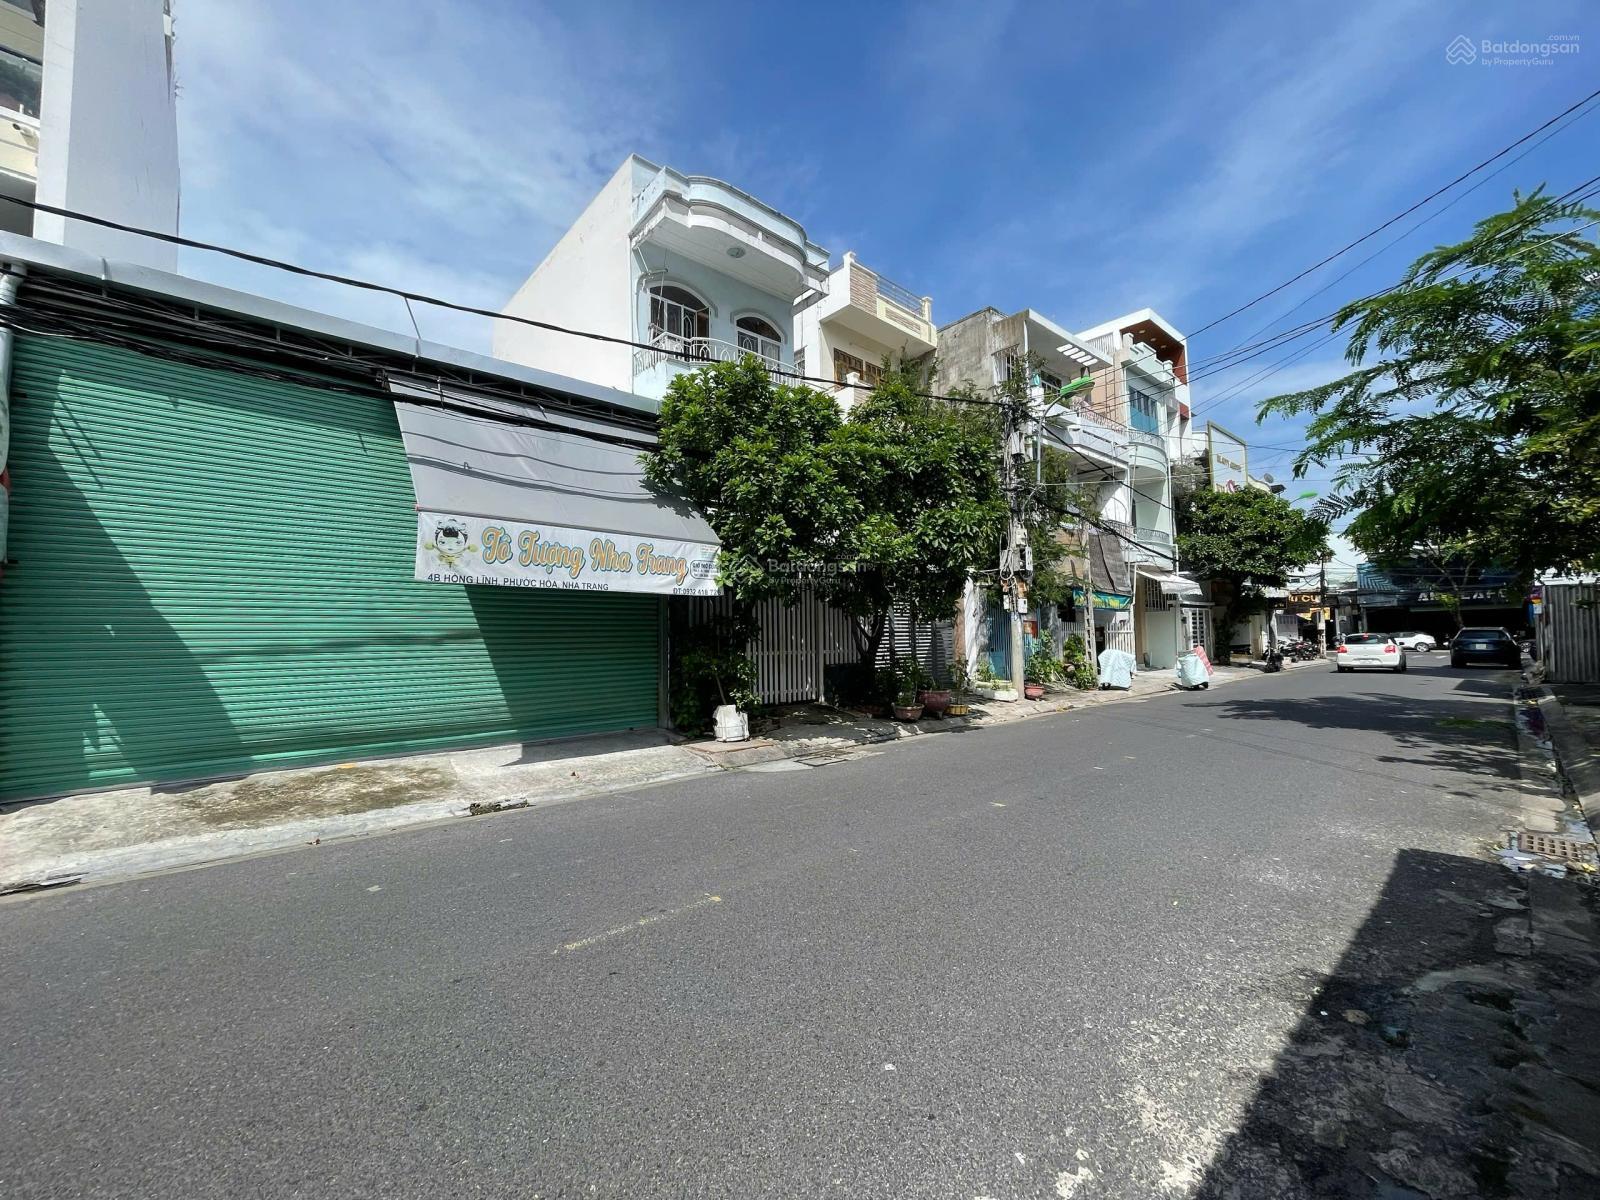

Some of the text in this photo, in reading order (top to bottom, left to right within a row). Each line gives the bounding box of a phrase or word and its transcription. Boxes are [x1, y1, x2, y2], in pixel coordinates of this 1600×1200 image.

[589, 538, 633, 572] Nha
[636, 543, 689, 586] Trang
[427, 573, 441, 582] 4B
[562, 581, 580, 590] NHA
[582, 582, 609, 591] TRANG
